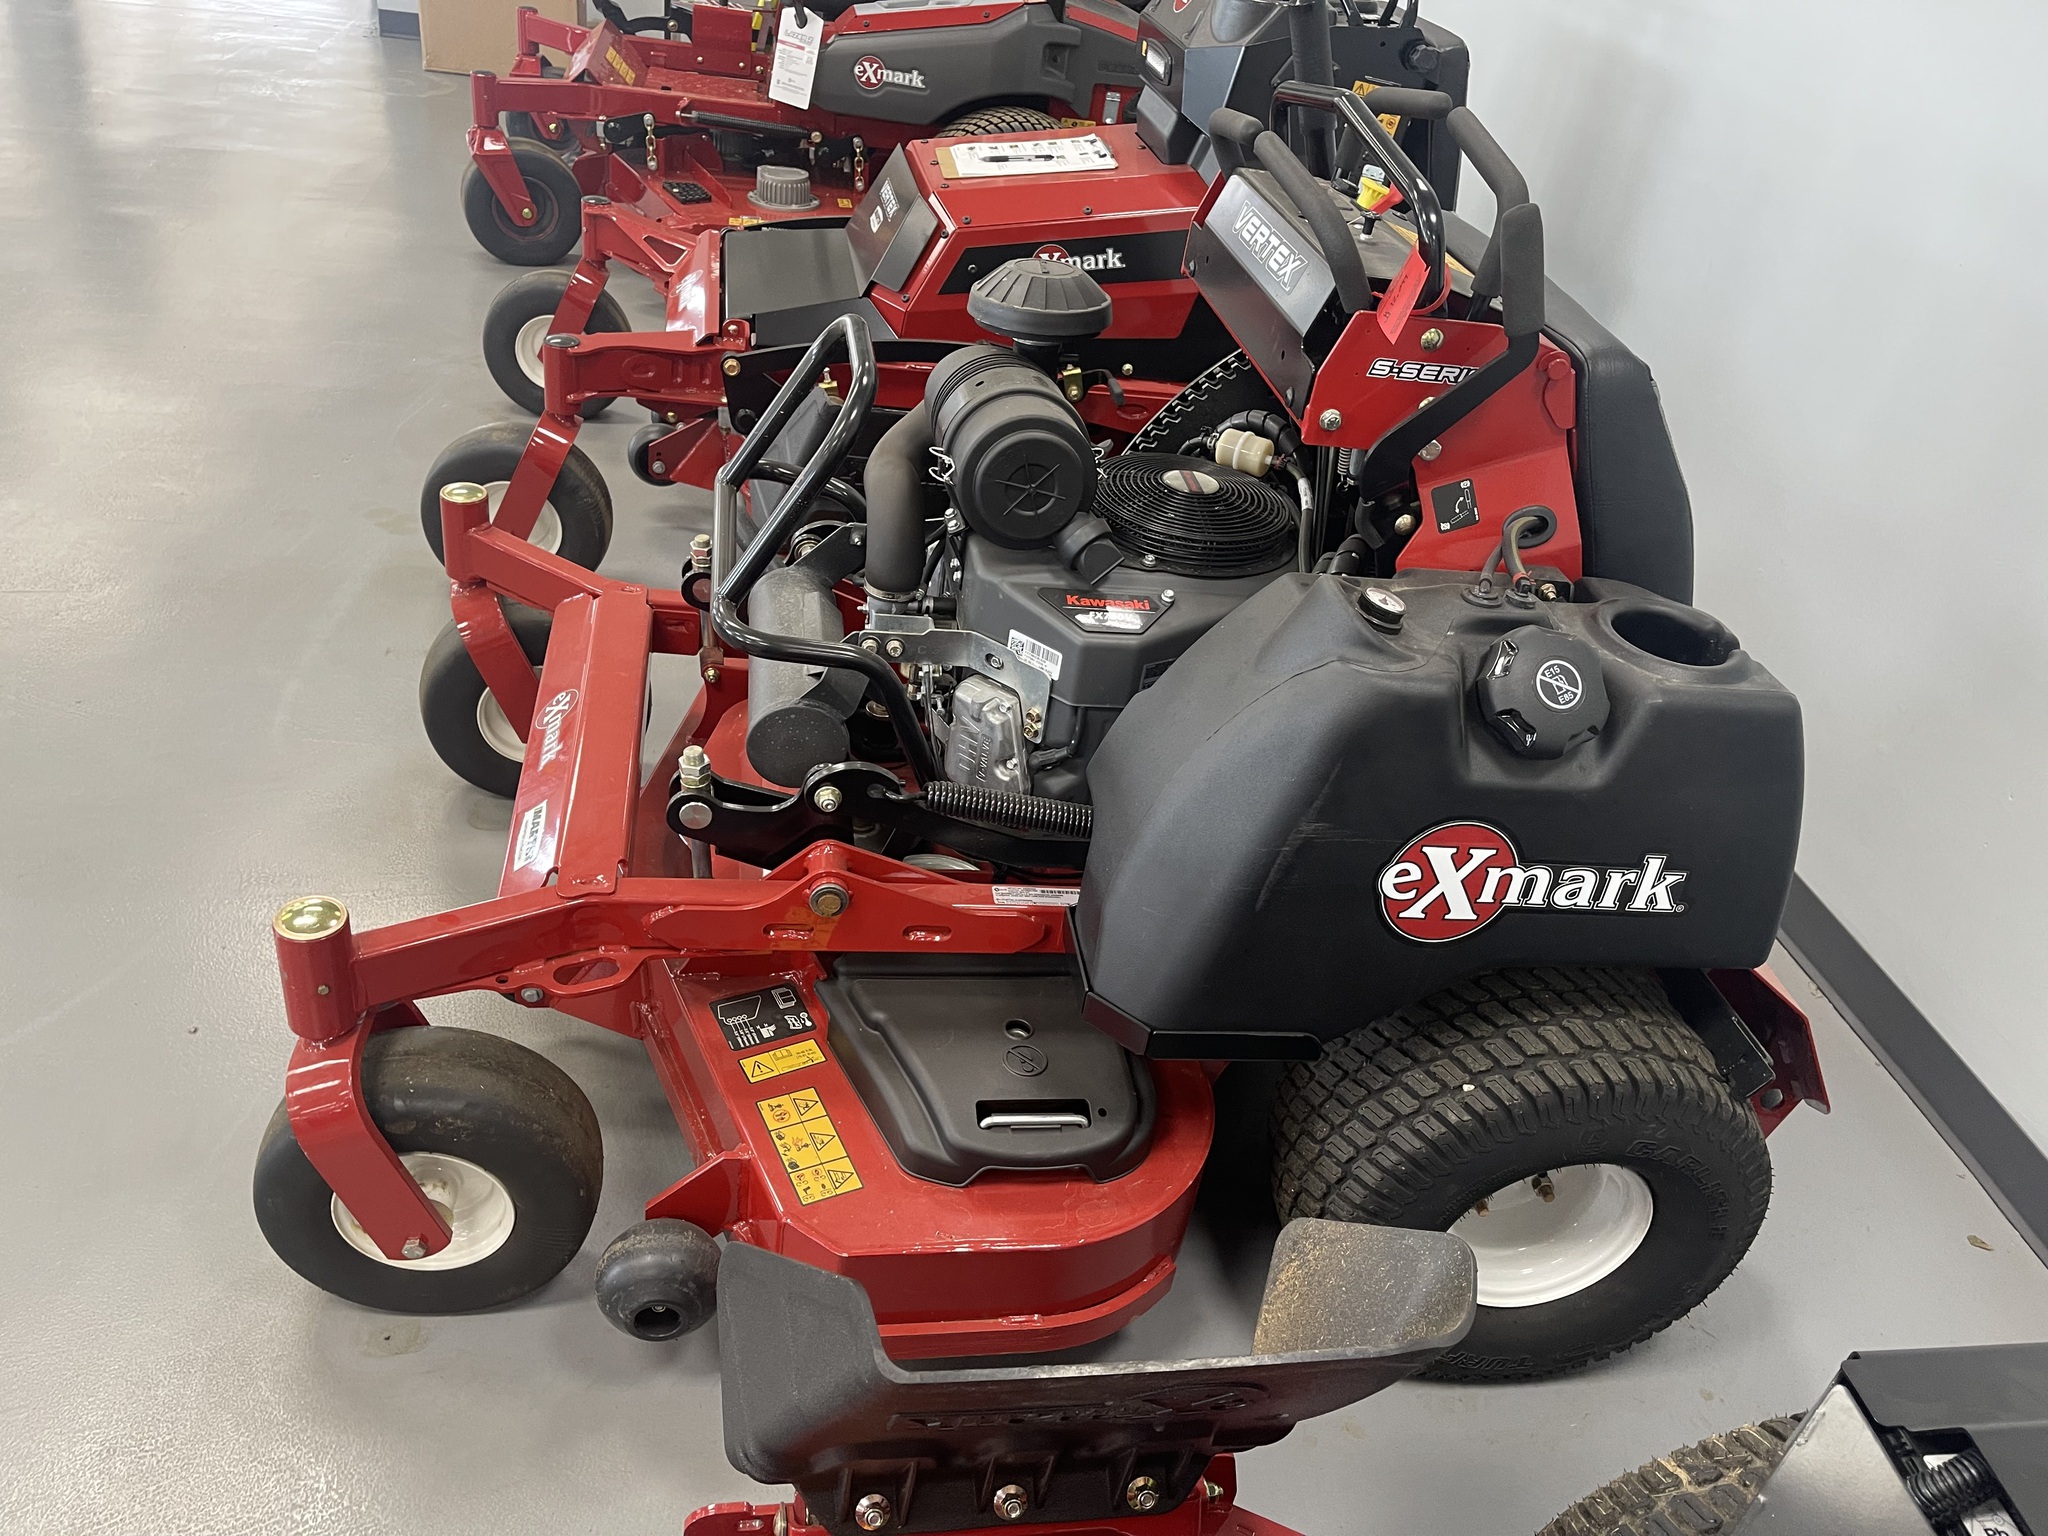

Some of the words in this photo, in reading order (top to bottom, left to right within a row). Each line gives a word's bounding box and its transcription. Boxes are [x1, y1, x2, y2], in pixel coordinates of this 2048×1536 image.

[1232, 200, 1308, 291] VERTEX
[1368, 358, 1479, 385] S-SERI
[1065, 594, 1151, 611] Kawasaki
[1543, 664, 1561, 678] E15
[1557, 691, 1575, 705] E85
